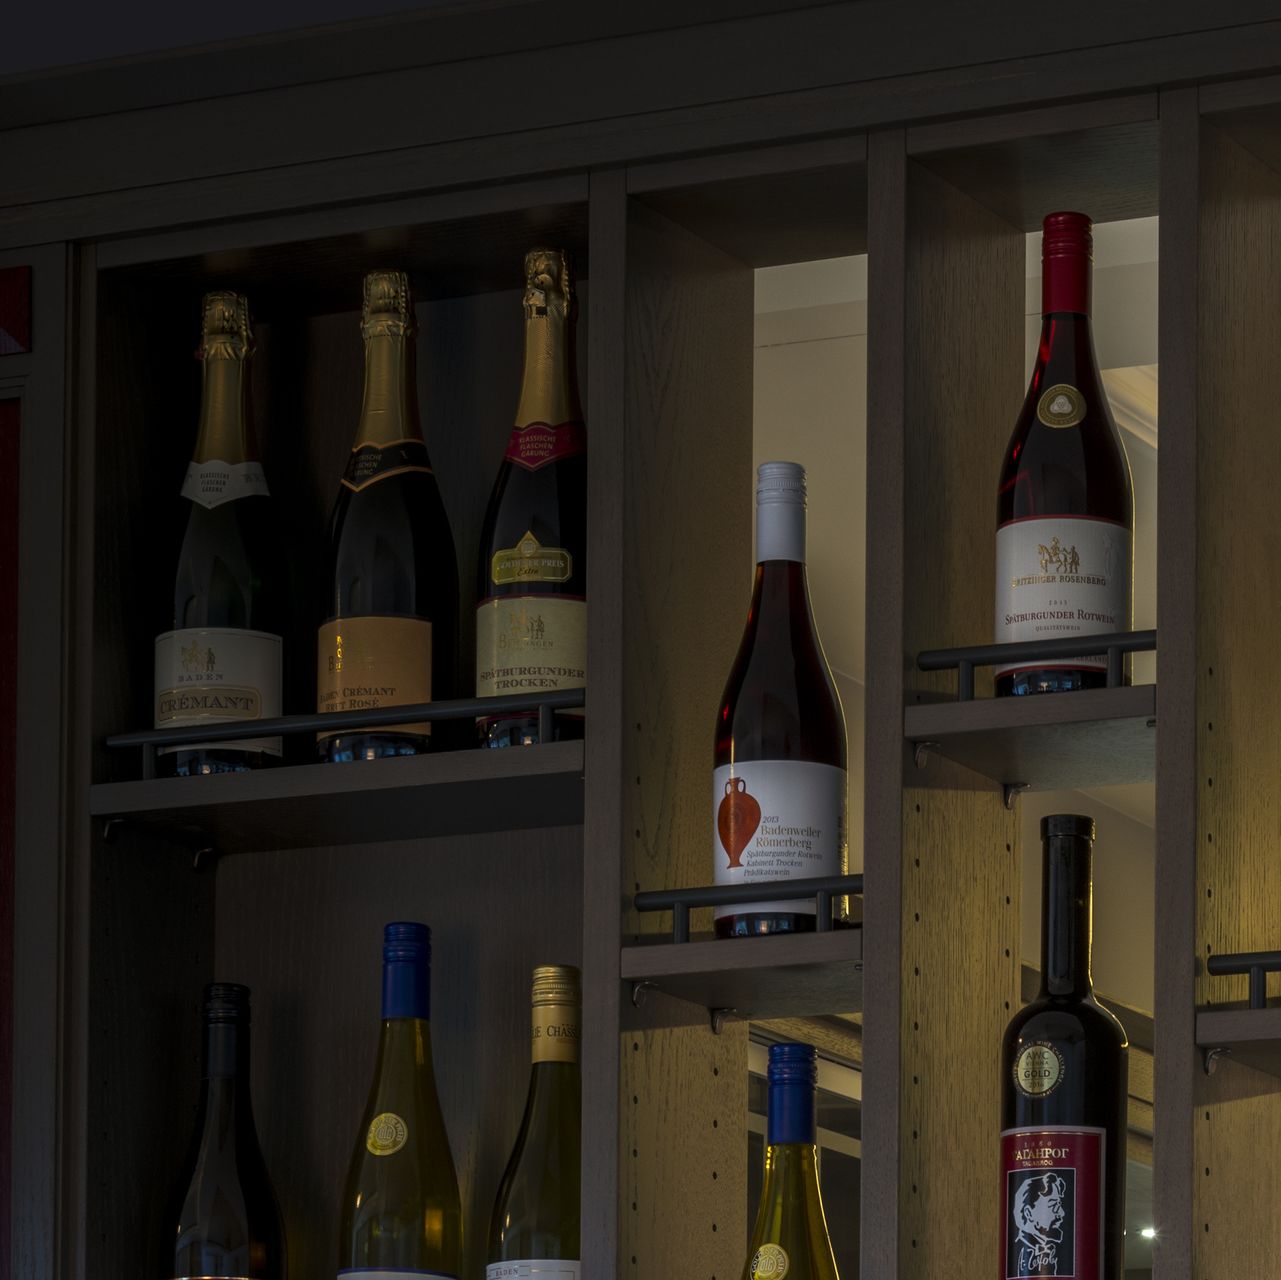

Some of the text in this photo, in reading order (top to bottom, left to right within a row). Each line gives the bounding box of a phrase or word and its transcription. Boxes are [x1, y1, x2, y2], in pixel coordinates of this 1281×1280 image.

[520, 441, 553, 450] FLASCHEN
[543, 559, 566, 568] PREIS
[1060, 574, 1106, 586] ROSENBERG
[1005, 609, 1115, 626] SPÄTBURGUNDER ROTWEIN
[481, 666, 585, 681] SPÄTBURGUNDER
[497, 679, 559, 690] TROCKEN
[342, 684, 397, 698] CRÉMANT
[160, 694, 255, 714] CRÉMANT
[354, 695, 384, 709] ROSÉ
[762, 814, 779, 824] 2013
[761, 825, 822, 839] Badenweiler
[755, 838, 812, 850] Römerberg
[746, 850, 796, 861] Spätburgunder
[776, 859, 803, 868] Trocken
[1026, 1051, 1050, 1060] AWC
[1023, 1069, 1051, 1079] GOLD
